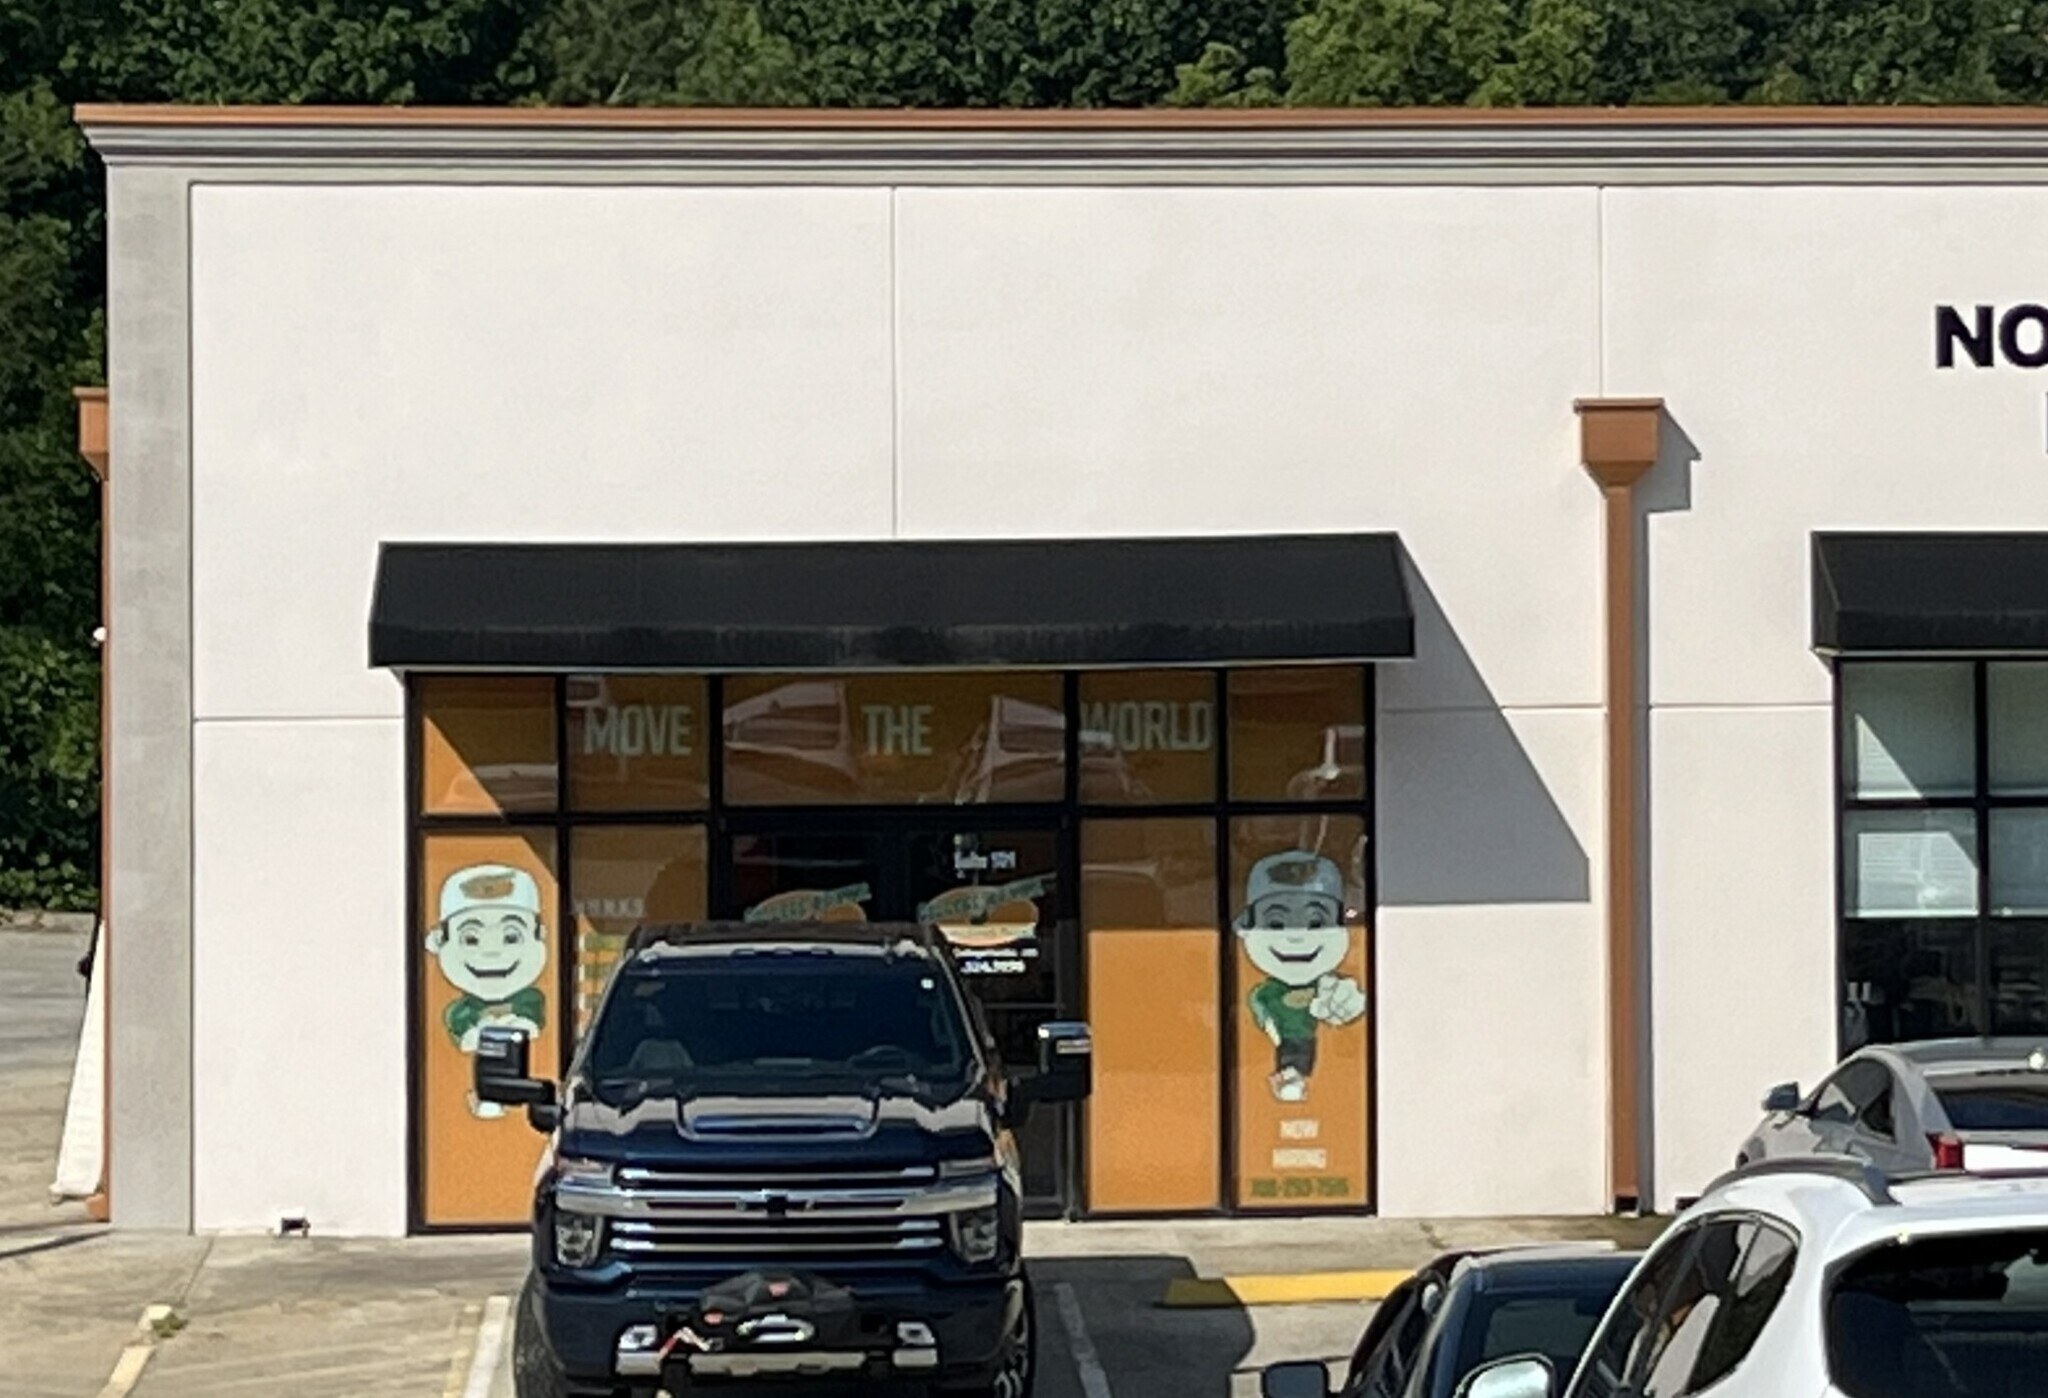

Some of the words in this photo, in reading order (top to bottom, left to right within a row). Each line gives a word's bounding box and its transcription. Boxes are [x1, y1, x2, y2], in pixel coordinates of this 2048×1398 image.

[584, 704, 692, 756] MOVE
[862, 705, 934, 755] THE
[1080, 701, 1212, 752] WORLD
